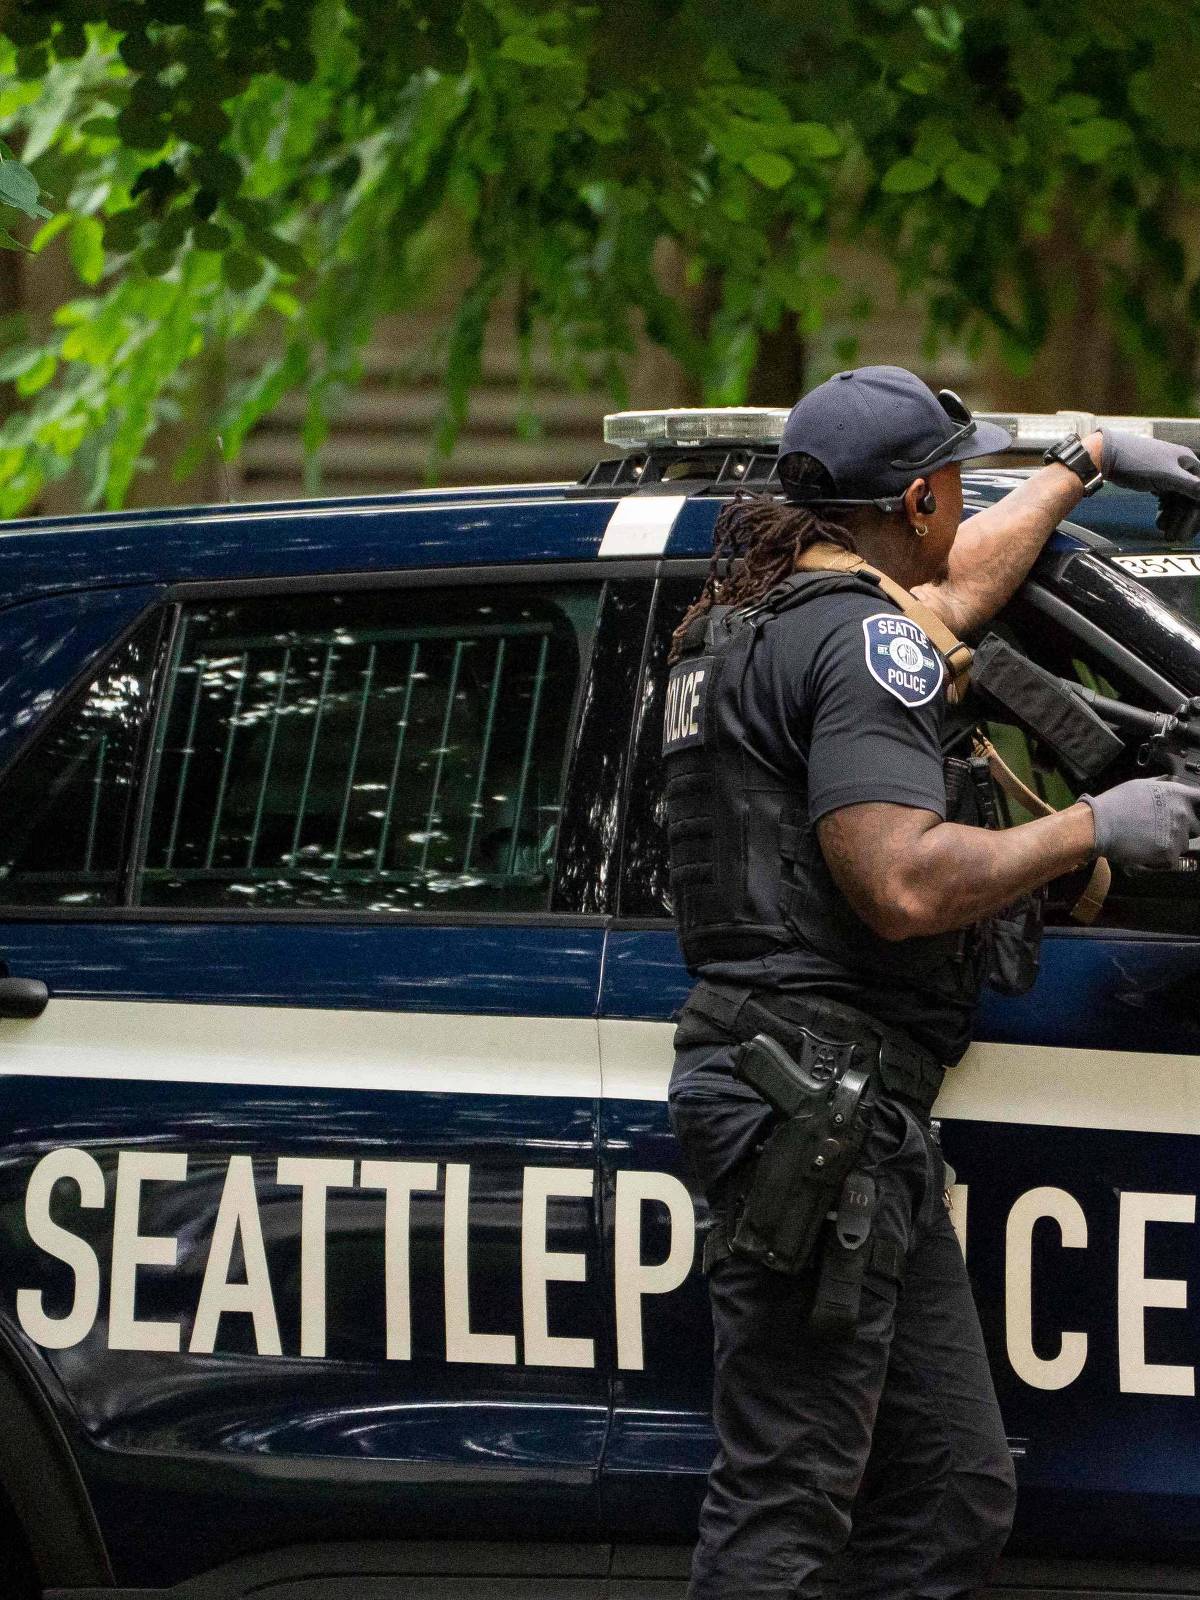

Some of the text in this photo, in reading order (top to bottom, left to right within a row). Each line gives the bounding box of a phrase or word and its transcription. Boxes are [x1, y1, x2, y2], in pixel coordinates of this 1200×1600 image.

[878, 620, 929, 649] SEATTLE
[887, 668, 926, 695] POLICE
[16, 1147, 1196, 1397] SEATTLE PCE
